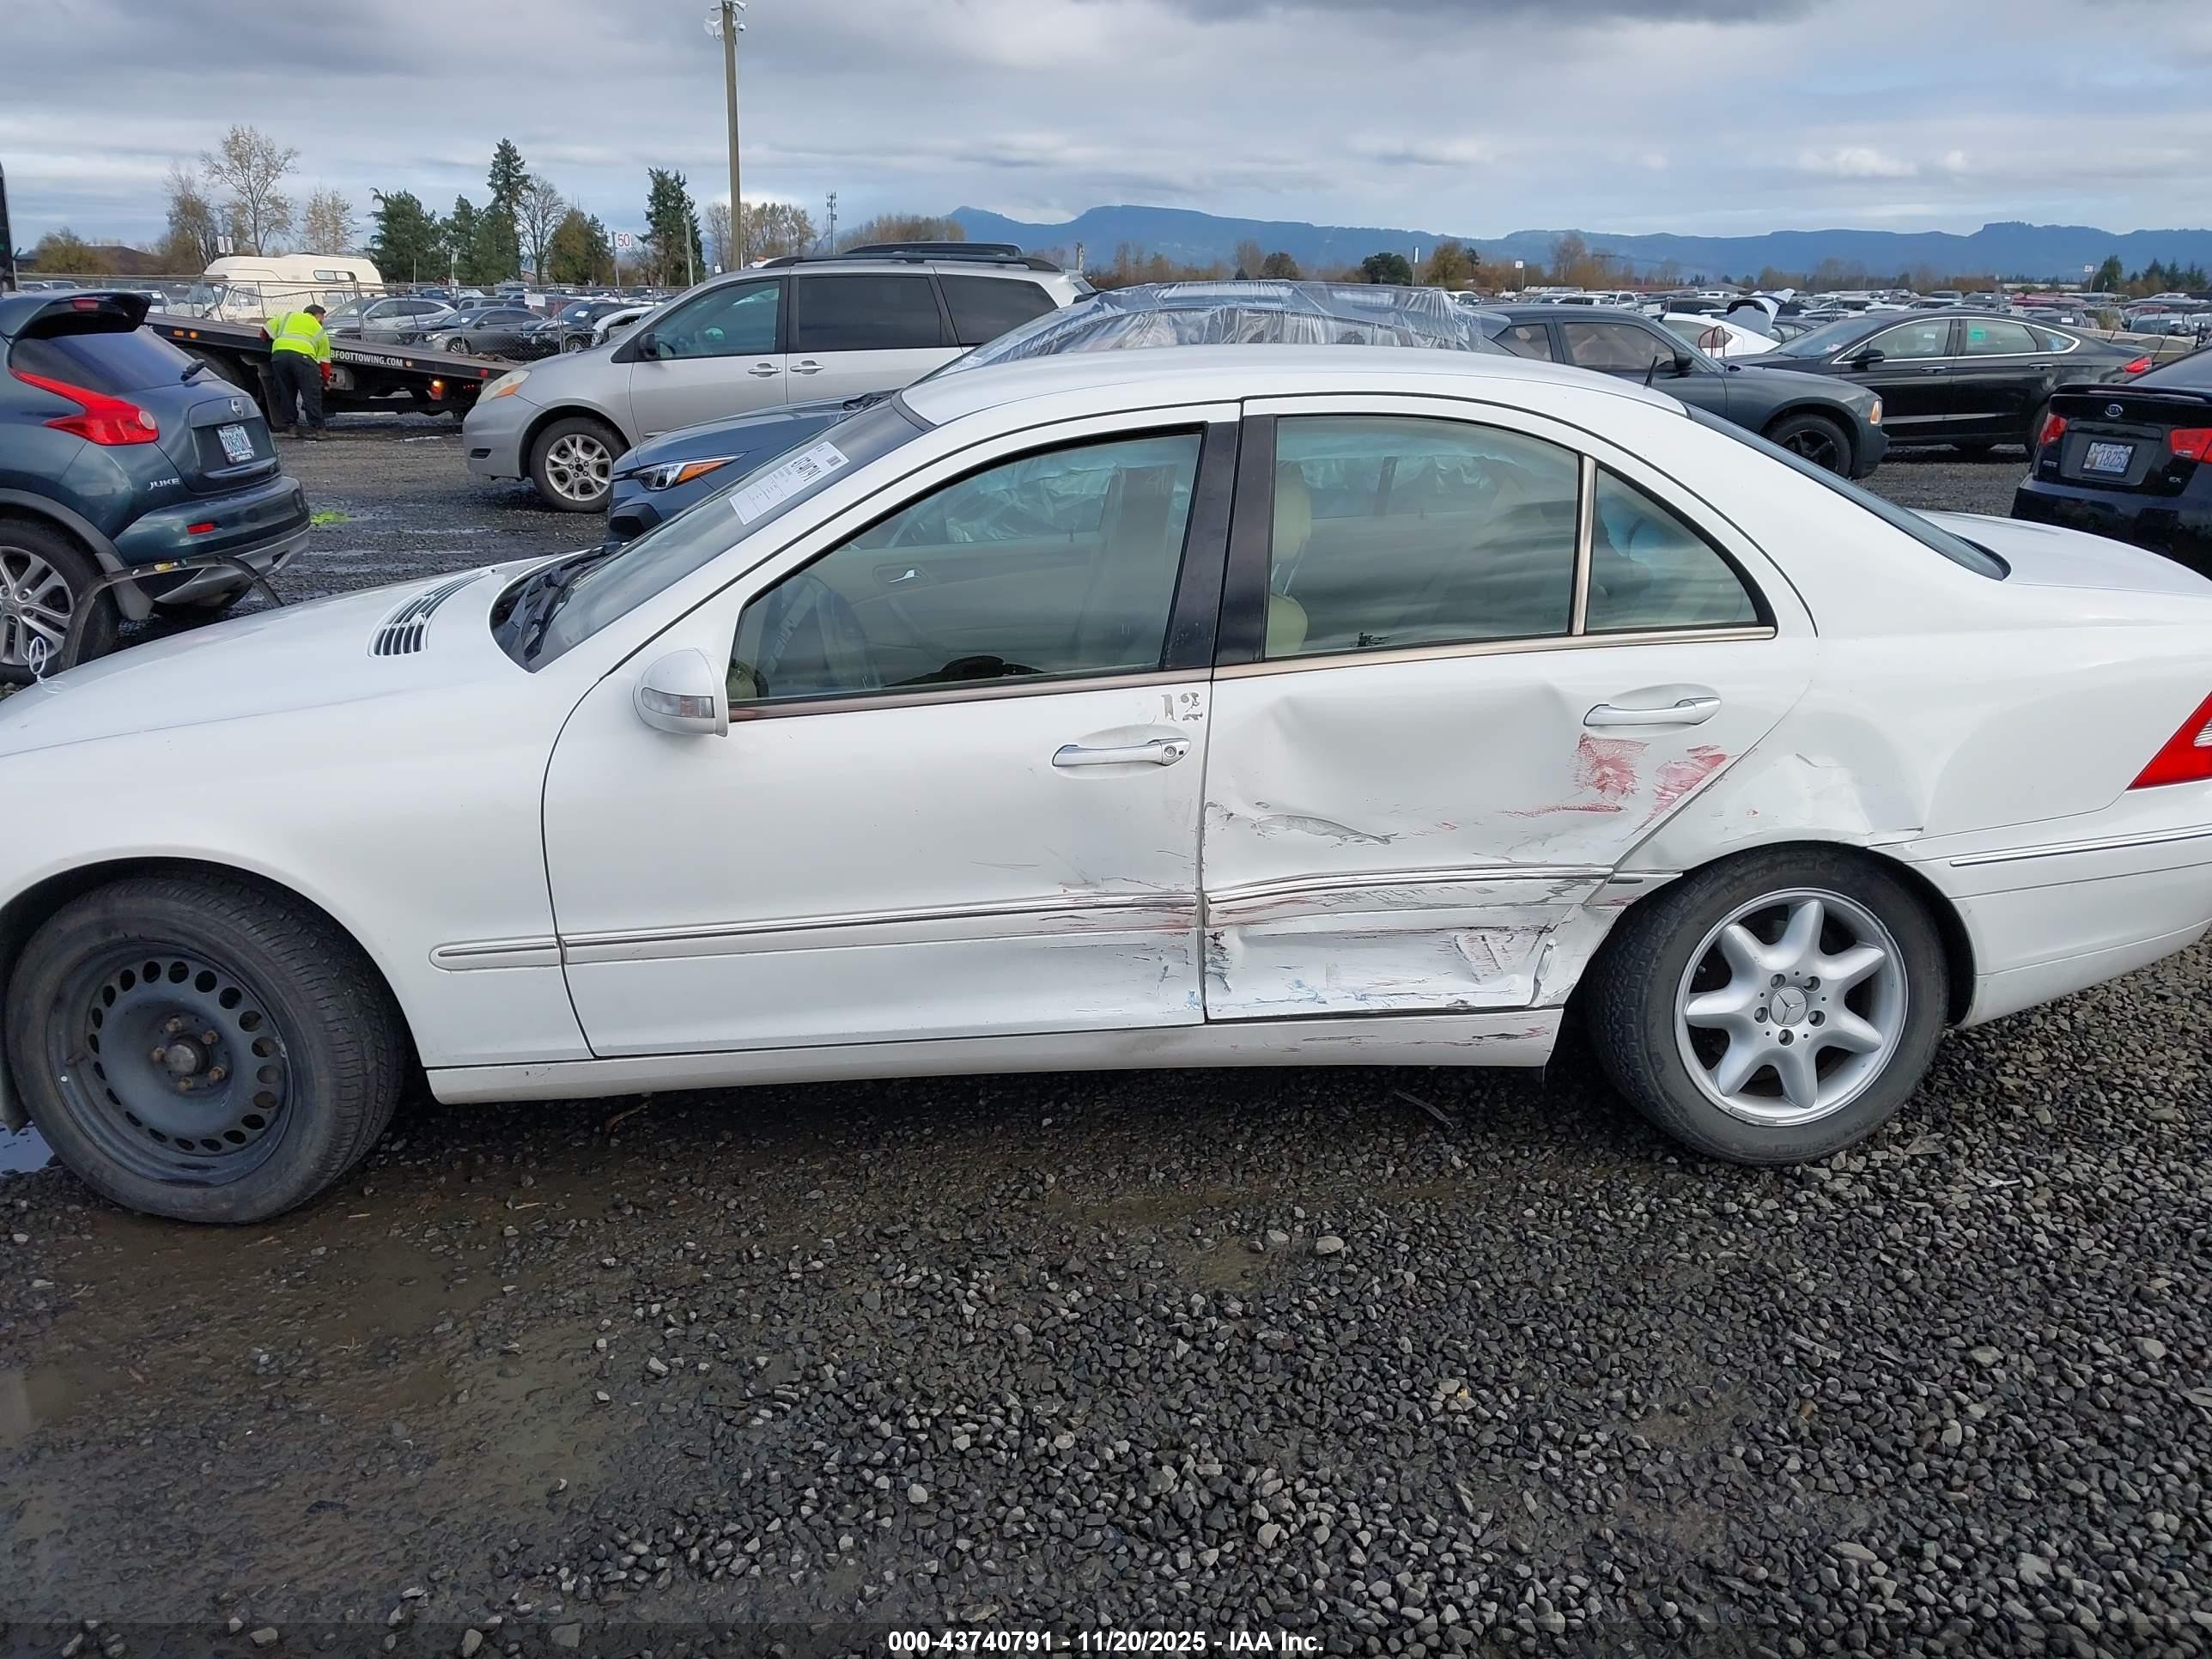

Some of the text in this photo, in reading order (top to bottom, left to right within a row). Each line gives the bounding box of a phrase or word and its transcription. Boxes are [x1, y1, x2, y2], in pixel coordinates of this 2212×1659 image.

[617, 234, 630, 247] 50
[147, 477, 180, 491] JUKE
[1160, 691, 1204, 722] 12
